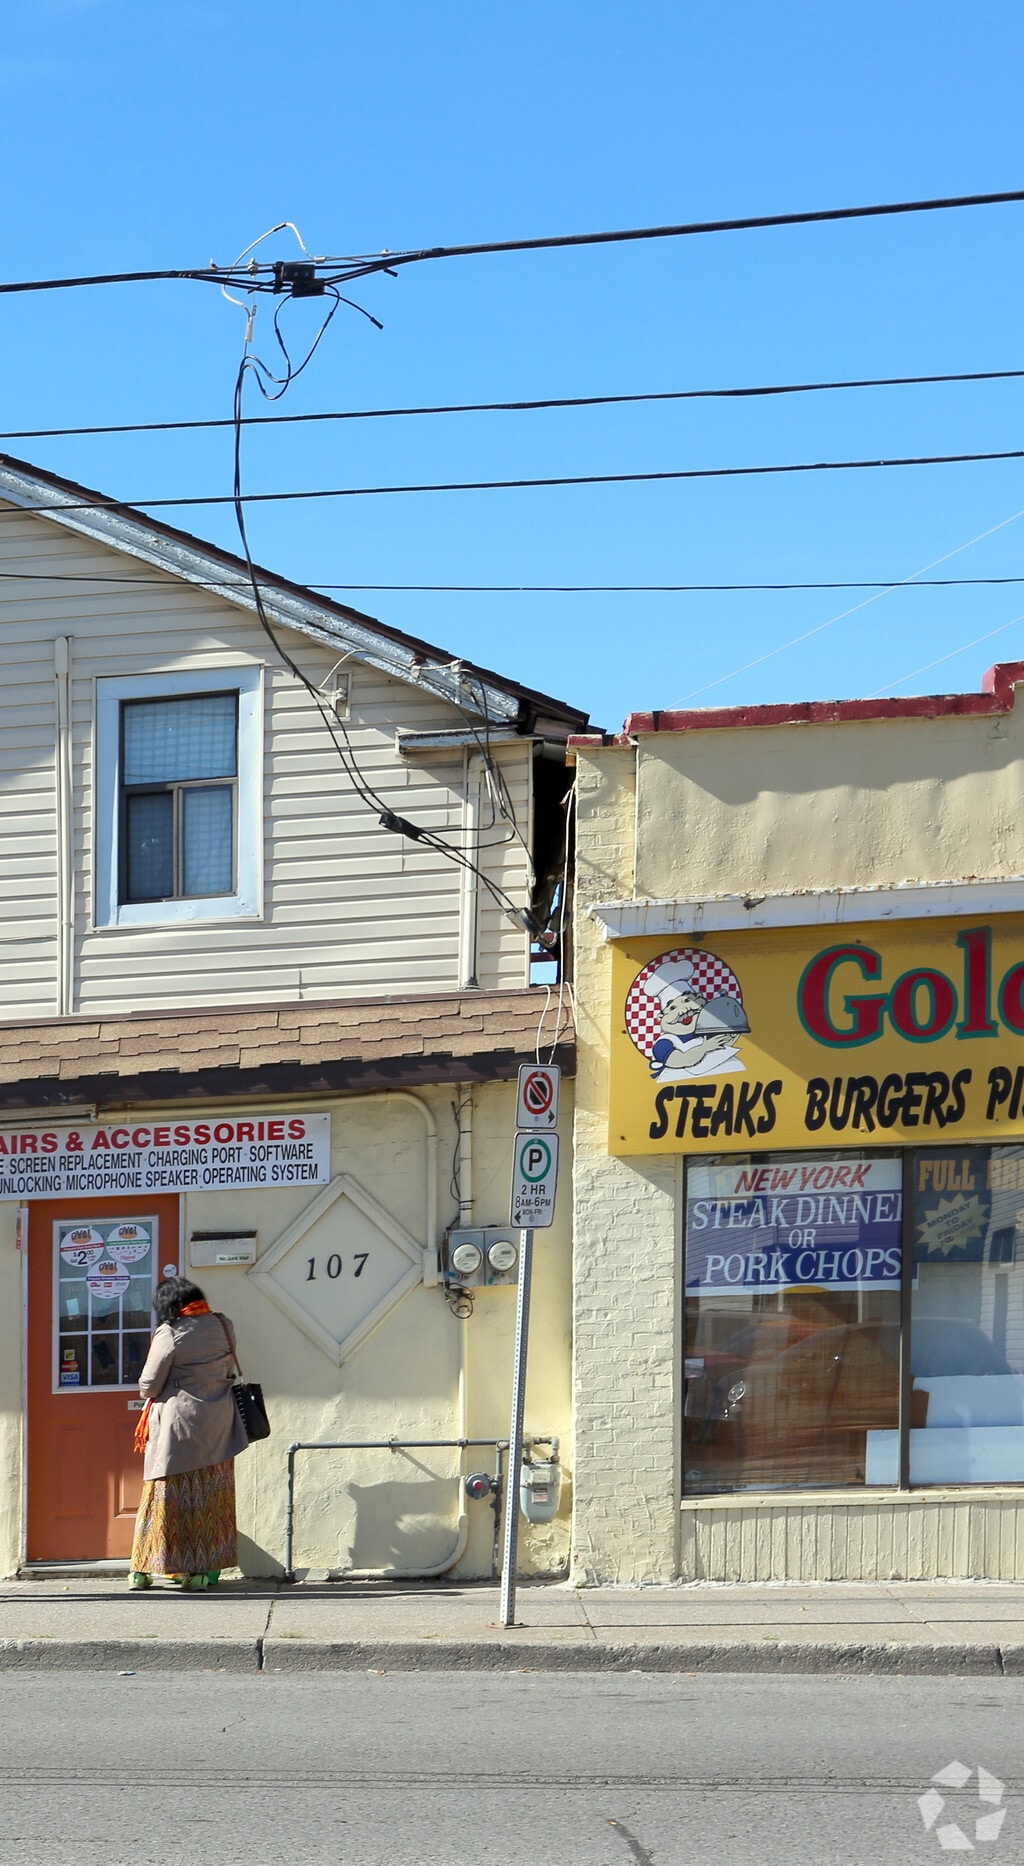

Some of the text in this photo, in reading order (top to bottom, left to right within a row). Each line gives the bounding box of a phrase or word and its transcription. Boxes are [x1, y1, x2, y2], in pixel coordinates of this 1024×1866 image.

[649, 1065, 1024, 1139] STEAKS BURGERS PI
[65, 1131, 84, 1152] &
[91, 1119, 306, 1150] ACCESSORIES
[9, 1155, 56, 1175] SCREEN
[59, 1152, 143, 1172] REPLACEMENT
[148, 1148, 208, 1168] CHARGING
[212, 1146, 243, 1164] PORT
[249, 1143, 314, 1163] SOFTWARE
[528, 1148, 543, 1171] P
[66, 1172, 142, 1191] MICROPHONE
[145, 1169, 199, 1188] SPEAKER
[203, 1166, 267, 1185] OPERATING
[271, 1163, 318, 1181] SYSTEM
[734, 1163, 872, 1194] NEW YORK
[918, 1159, 1024, 1191] FULL BR
[521, 1184, 546, 1195] 2 HR
[692, 1197, 790, 1230] STEAK
[927, 1201, 970, 1228] MONDAY
[944, 1217, 959, 1227] TO
[788, 1228, 816, 1249] OR
[937, 1217, 973, 1239] FRIDAY
[306, 1253, 369, 1281] 107
[703, 1247, 902, 1284] PORK CHOPS
